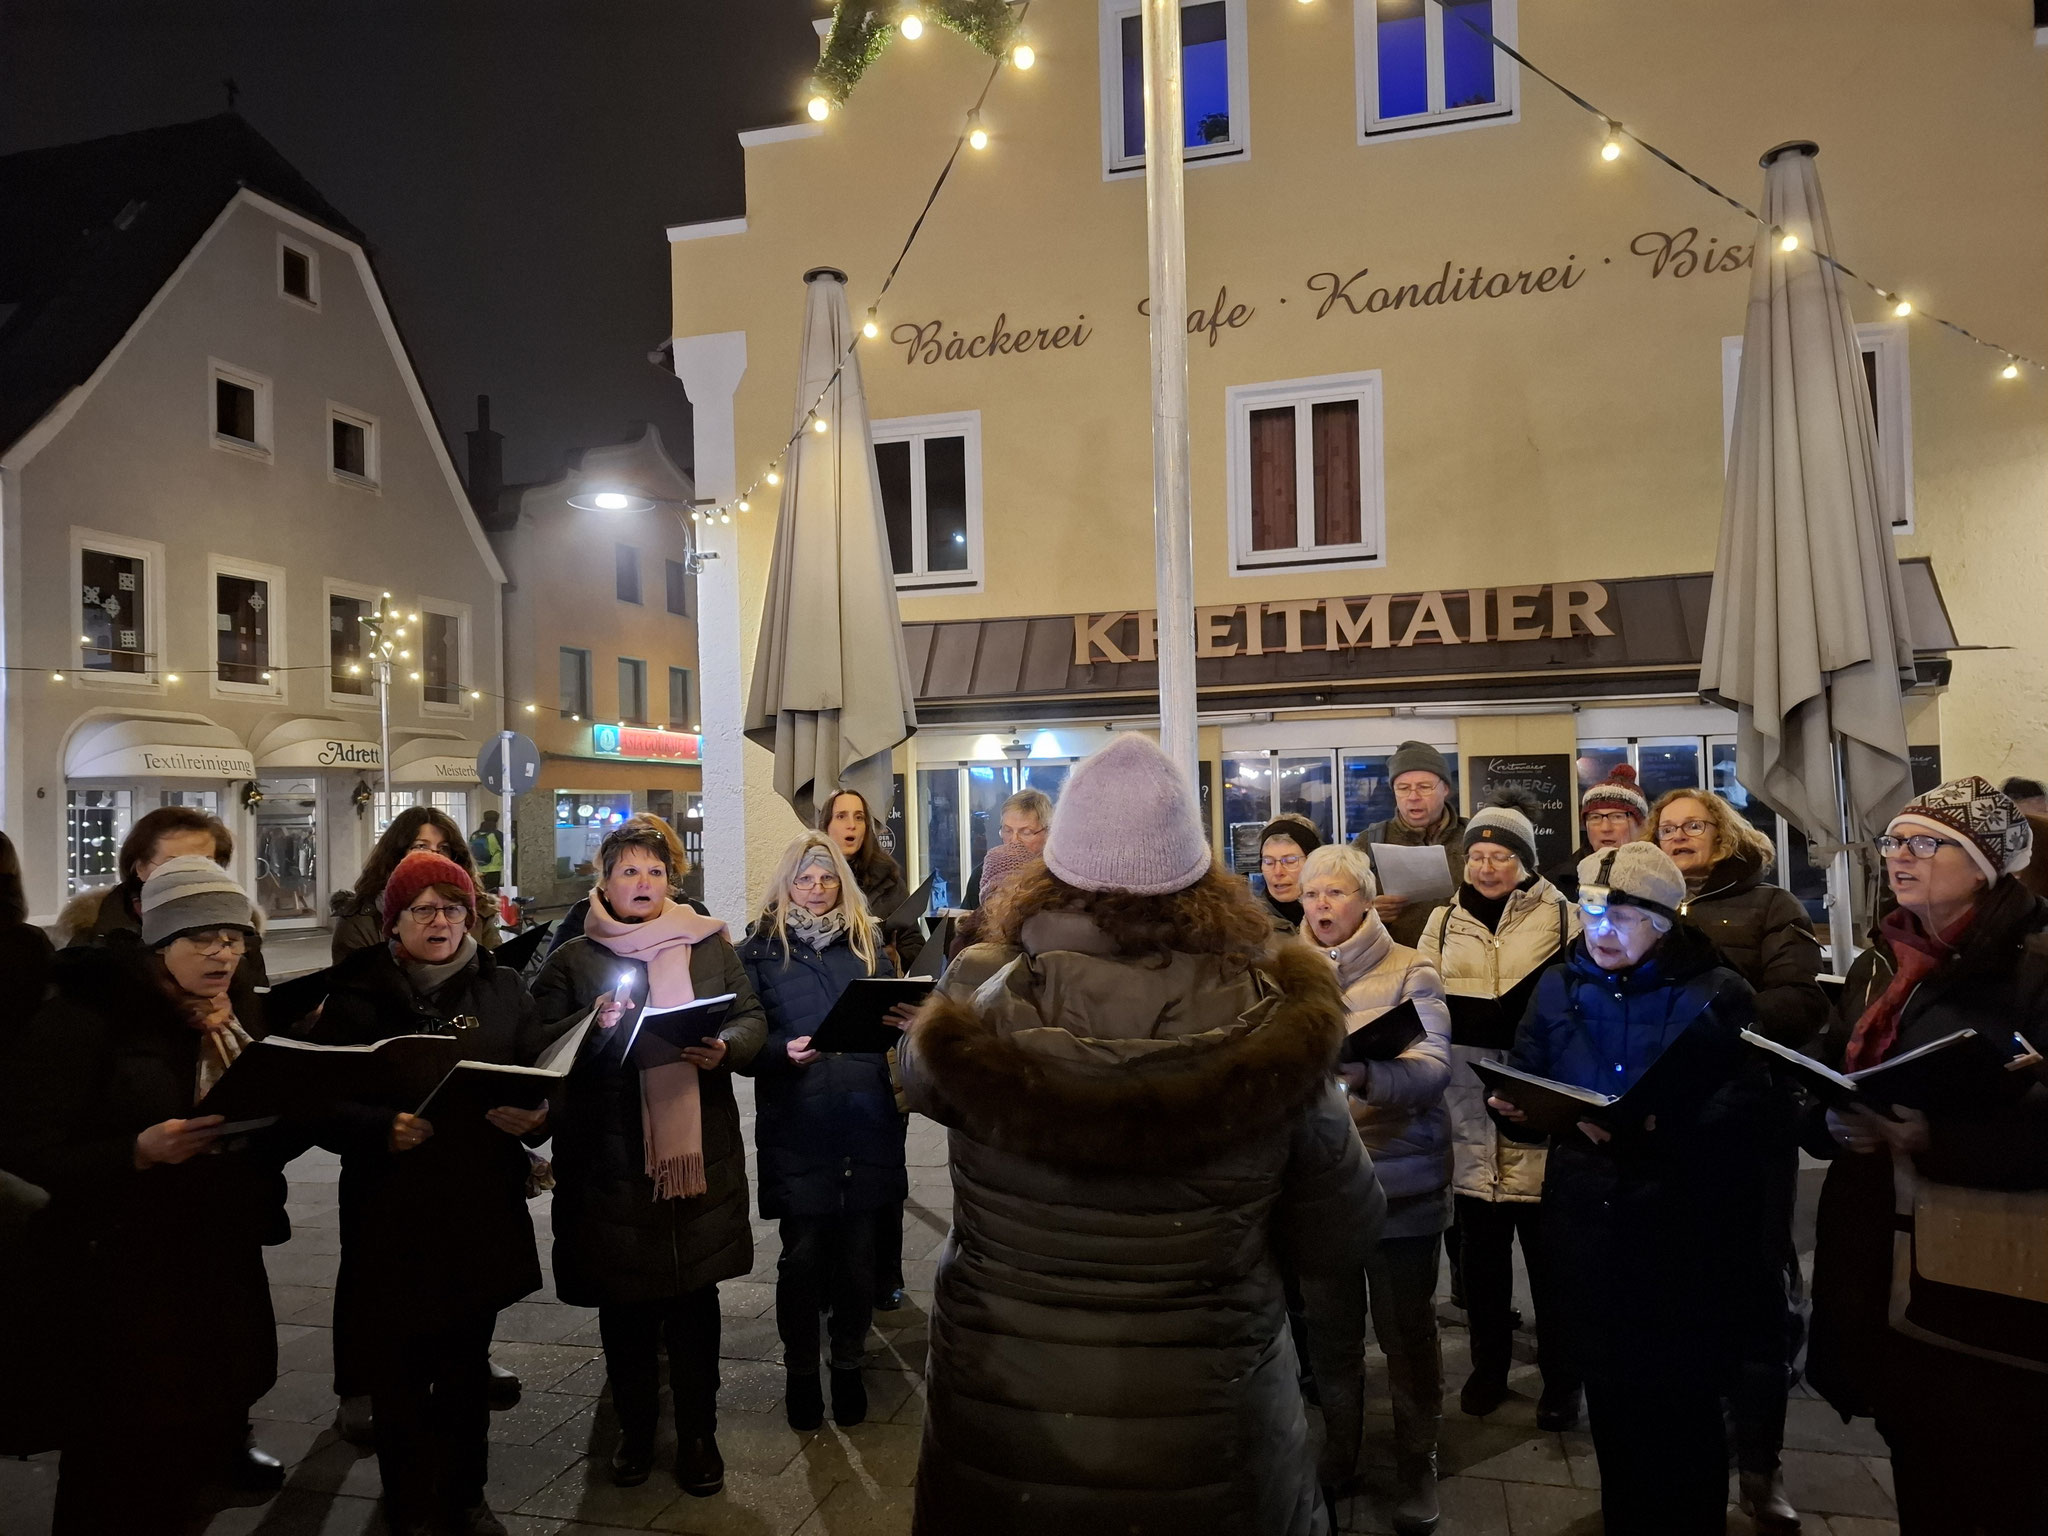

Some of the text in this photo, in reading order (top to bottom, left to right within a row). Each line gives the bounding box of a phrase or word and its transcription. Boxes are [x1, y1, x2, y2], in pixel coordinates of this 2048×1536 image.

[1306, 254, 1586, 320] Konditorei
[142, 752, 252, 776] Textilreinigung
[317, 741, 381, 765] Adrett
[434, 763, 478, 777] Meisterb
[36, 786, 46, 799] 6
